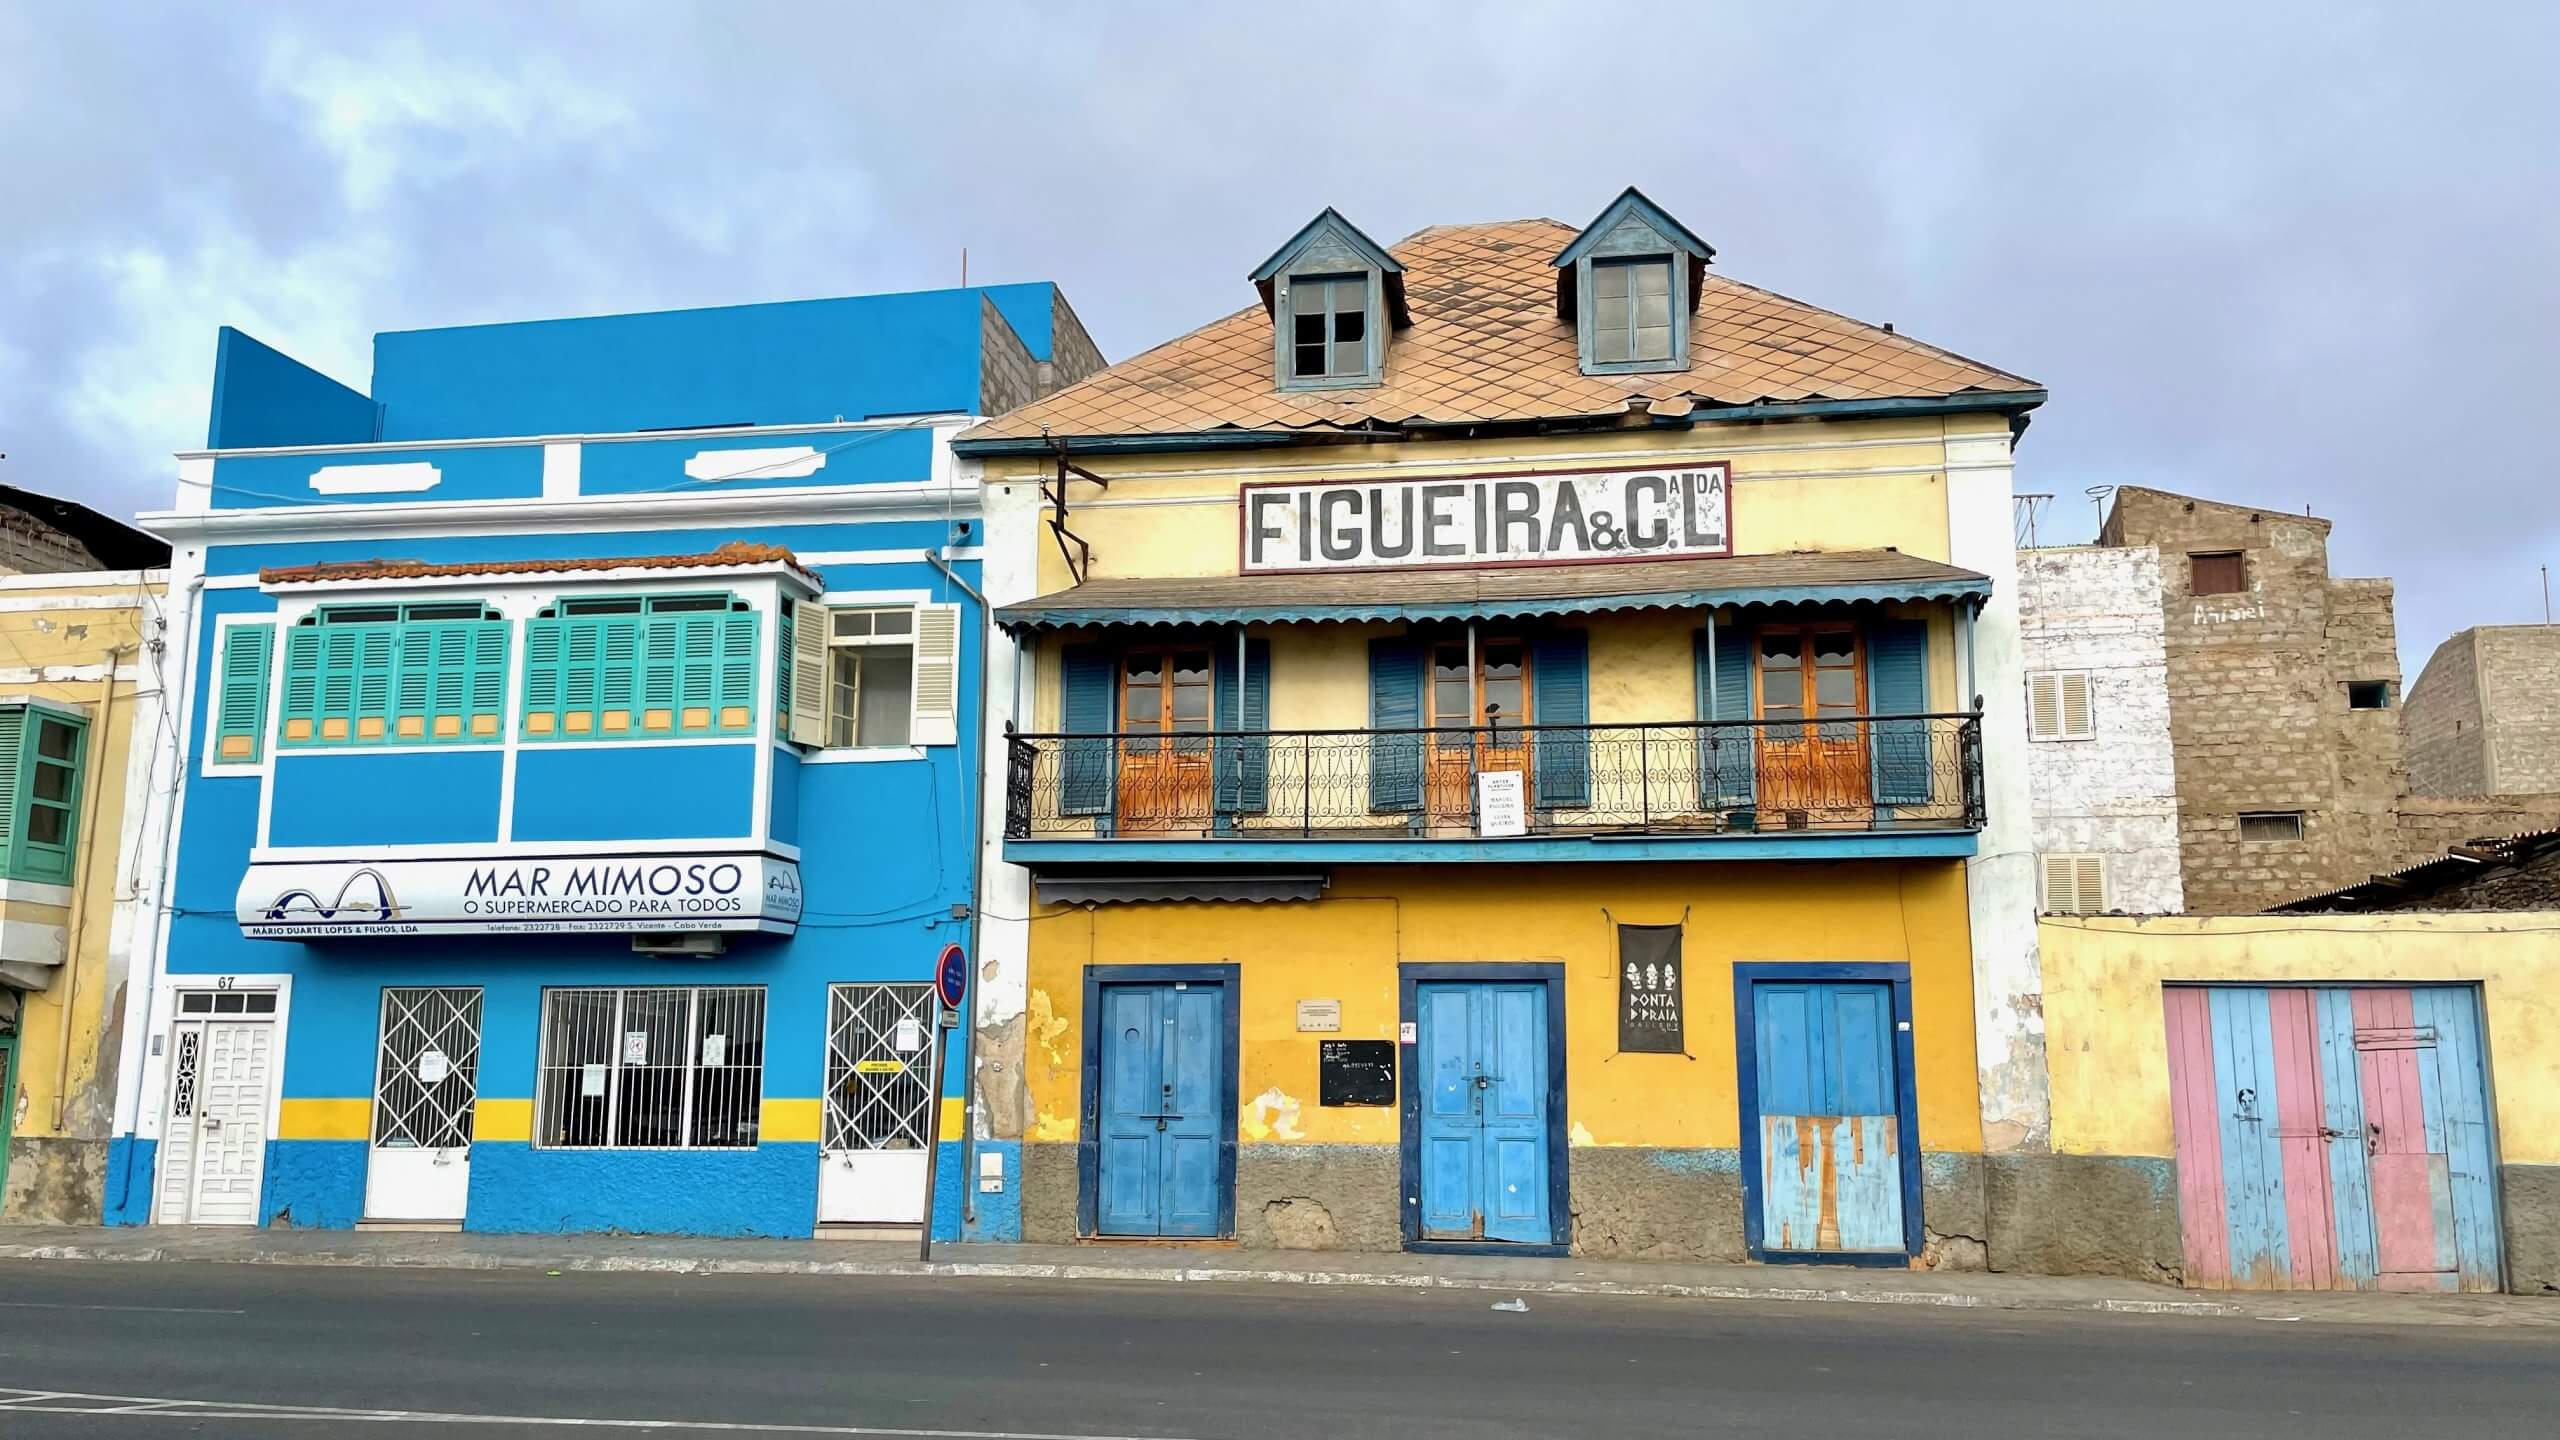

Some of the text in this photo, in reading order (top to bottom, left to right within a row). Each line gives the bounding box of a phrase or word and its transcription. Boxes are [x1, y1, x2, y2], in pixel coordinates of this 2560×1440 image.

[1251, 480, 1591, 564] FIGUEIRA
[1589, 510, 1625, 551] &
[464, 863, 742, 897] MAR MIMOSO
[464, 897, 741, 914] O SUPERMERCADO PARA TODOS
[287, 925, 322, 935] DUARTE
[325, 925, 353, 934] LOPES
[356, 925, 362, 934] &
[401, 925, 418, 934] LDA
[673, 921, 696, 930] Cabo
[698, 921, 723, 929] Verde
[218, 976, 236, 991] 67
[1631, 993, 1675, 1007] PONTA
